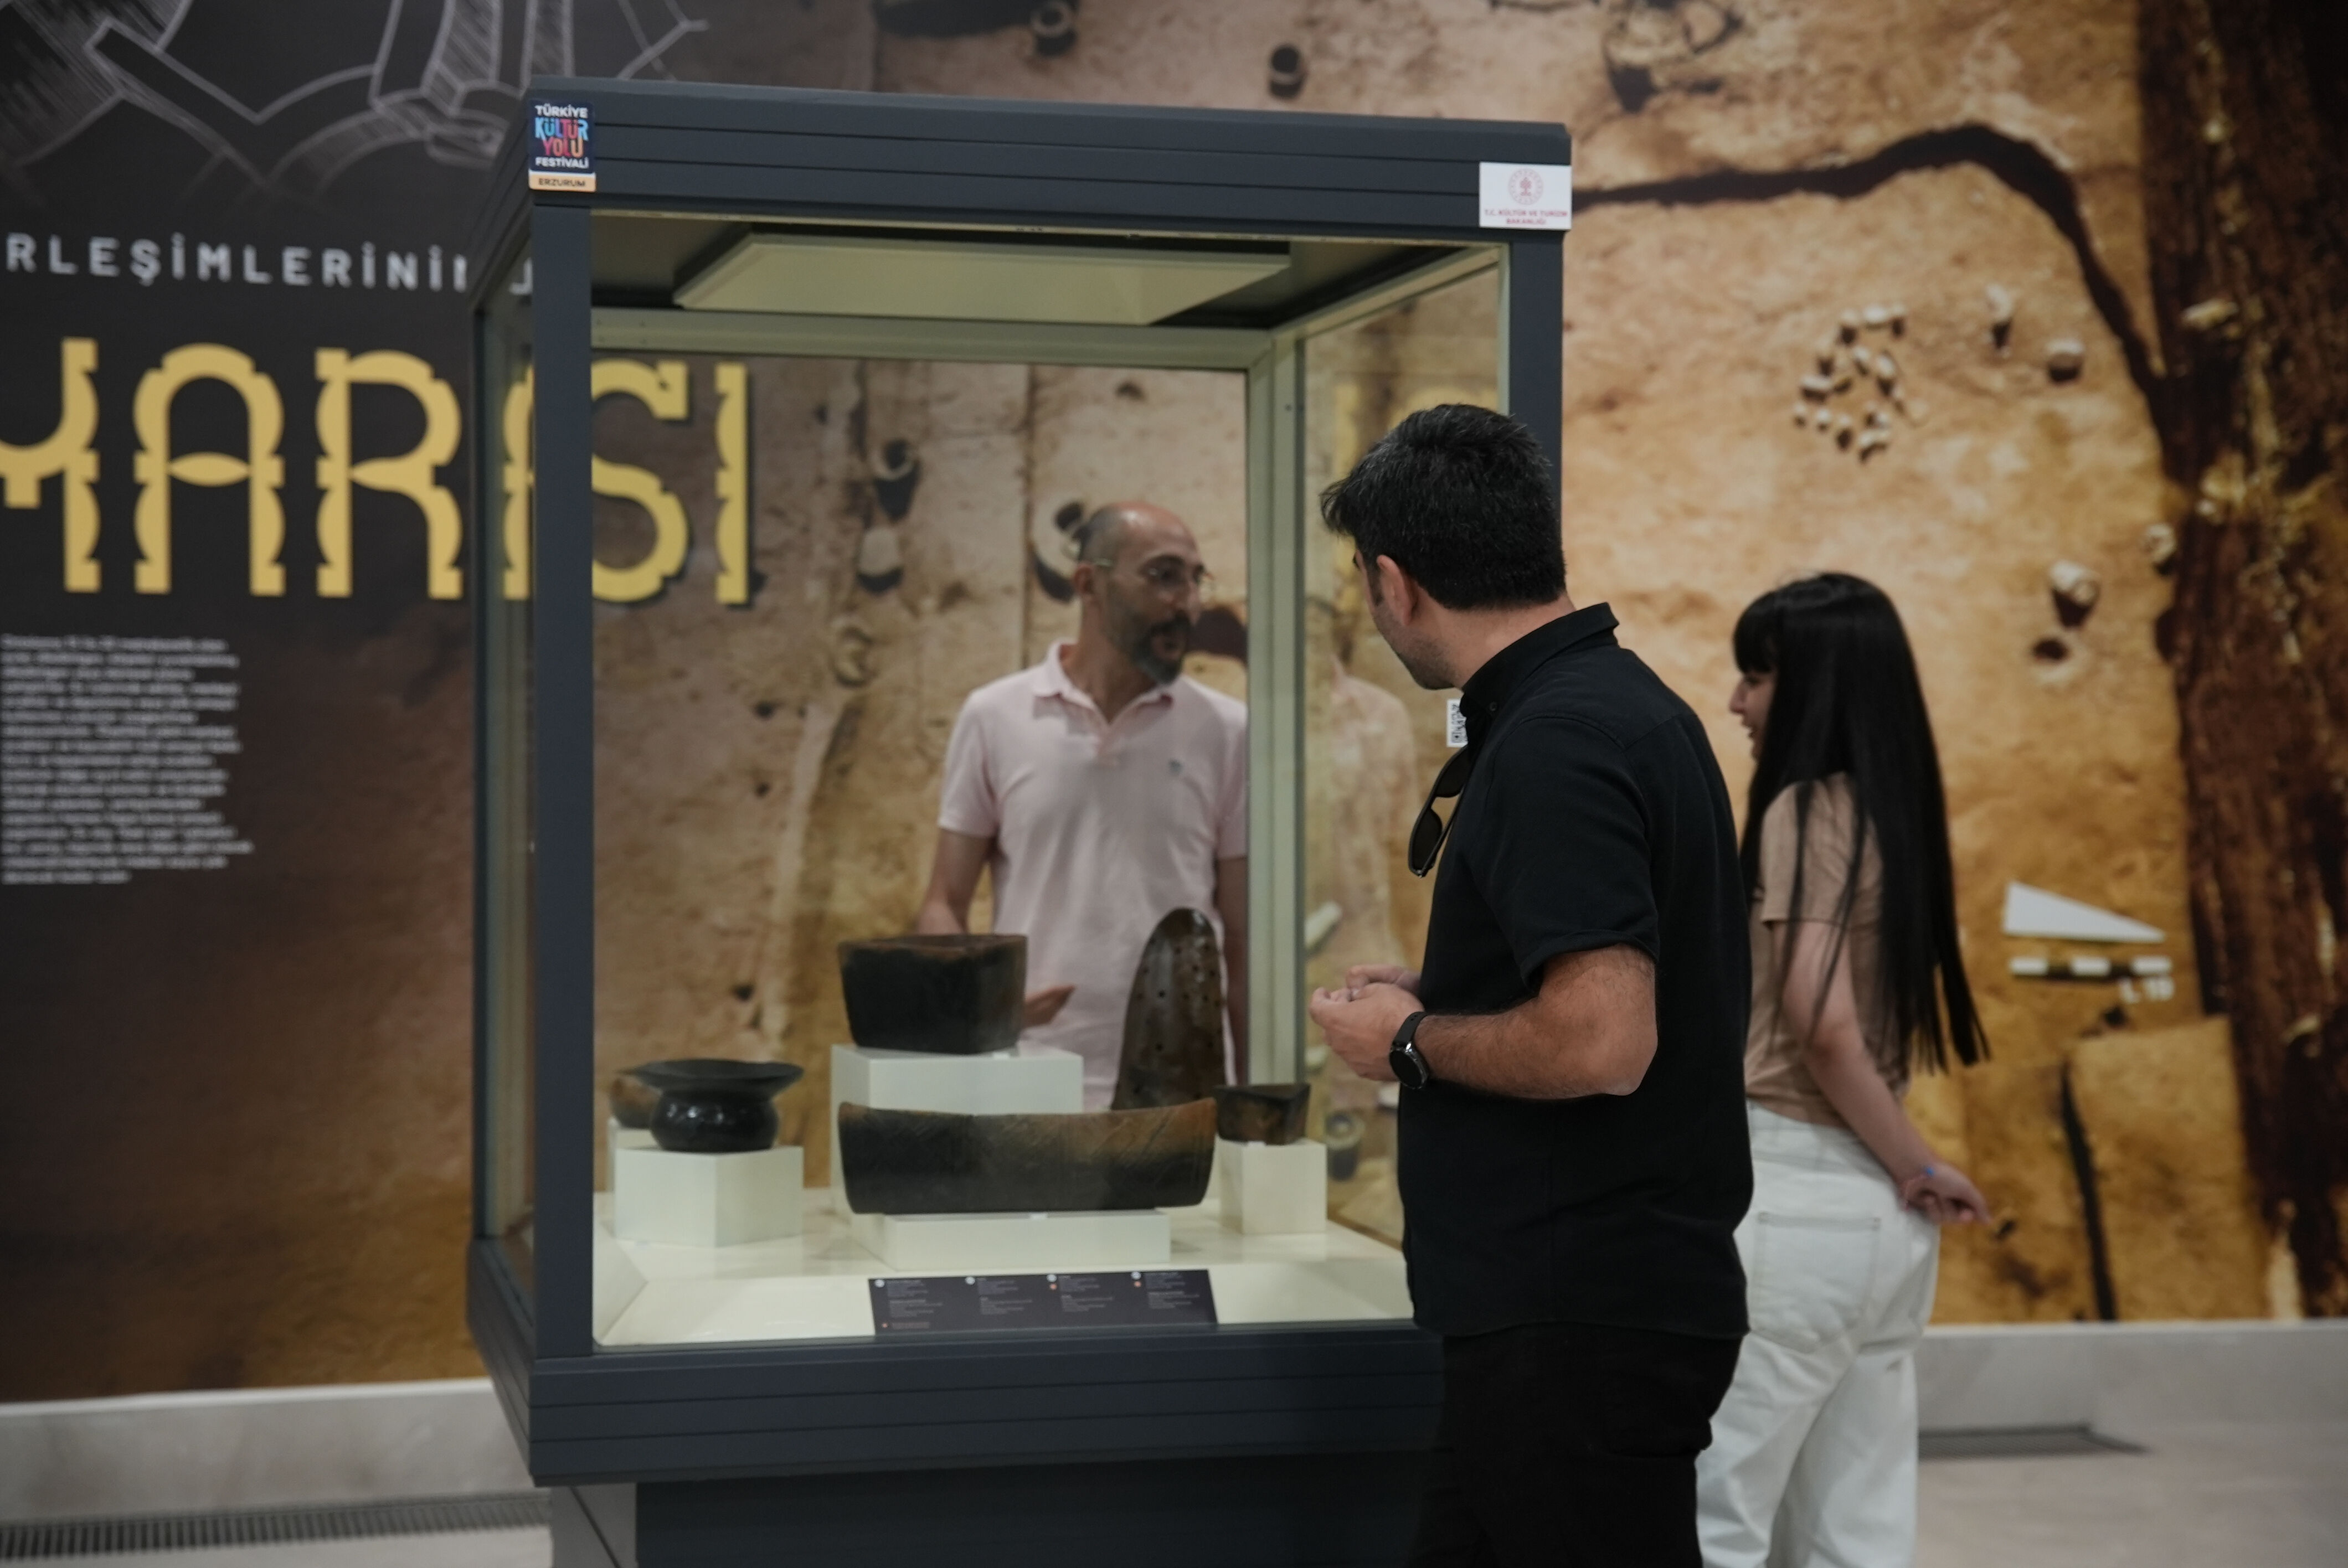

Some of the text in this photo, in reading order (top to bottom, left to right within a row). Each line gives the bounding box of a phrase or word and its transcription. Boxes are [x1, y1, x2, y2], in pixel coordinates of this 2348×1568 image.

[534, 103, 588, 118] TÜRKİYE
[535, 117, 589, 141] KÜLTÜR
[543, 137, 584, 158] YOLU
[535, 156, 590, 168] FESTİVALİ
[538, 178, 586, 187] ERZURUM
